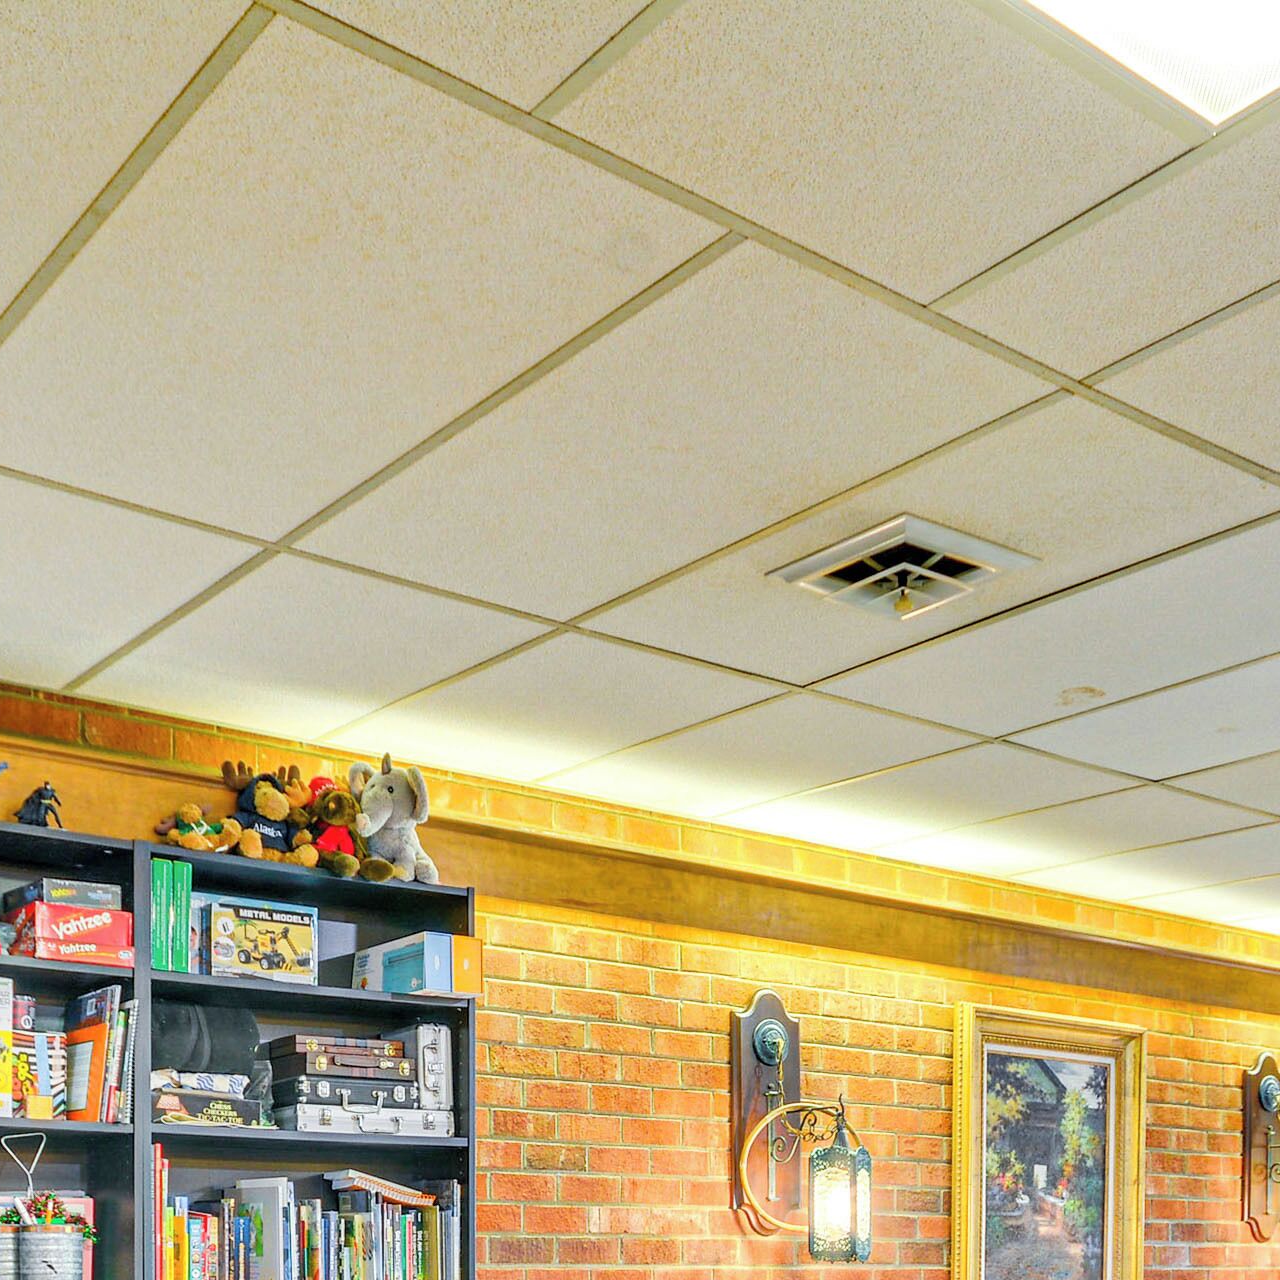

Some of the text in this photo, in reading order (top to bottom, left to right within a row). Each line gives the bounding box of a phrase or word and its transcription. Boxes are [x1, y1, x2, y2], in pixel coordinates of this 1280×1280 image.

[238, 907, 310, 924] METAL MODELS
[51, 911, 112, 940] Yahtzee
[58, 943, 97, 955] Yahtzee
